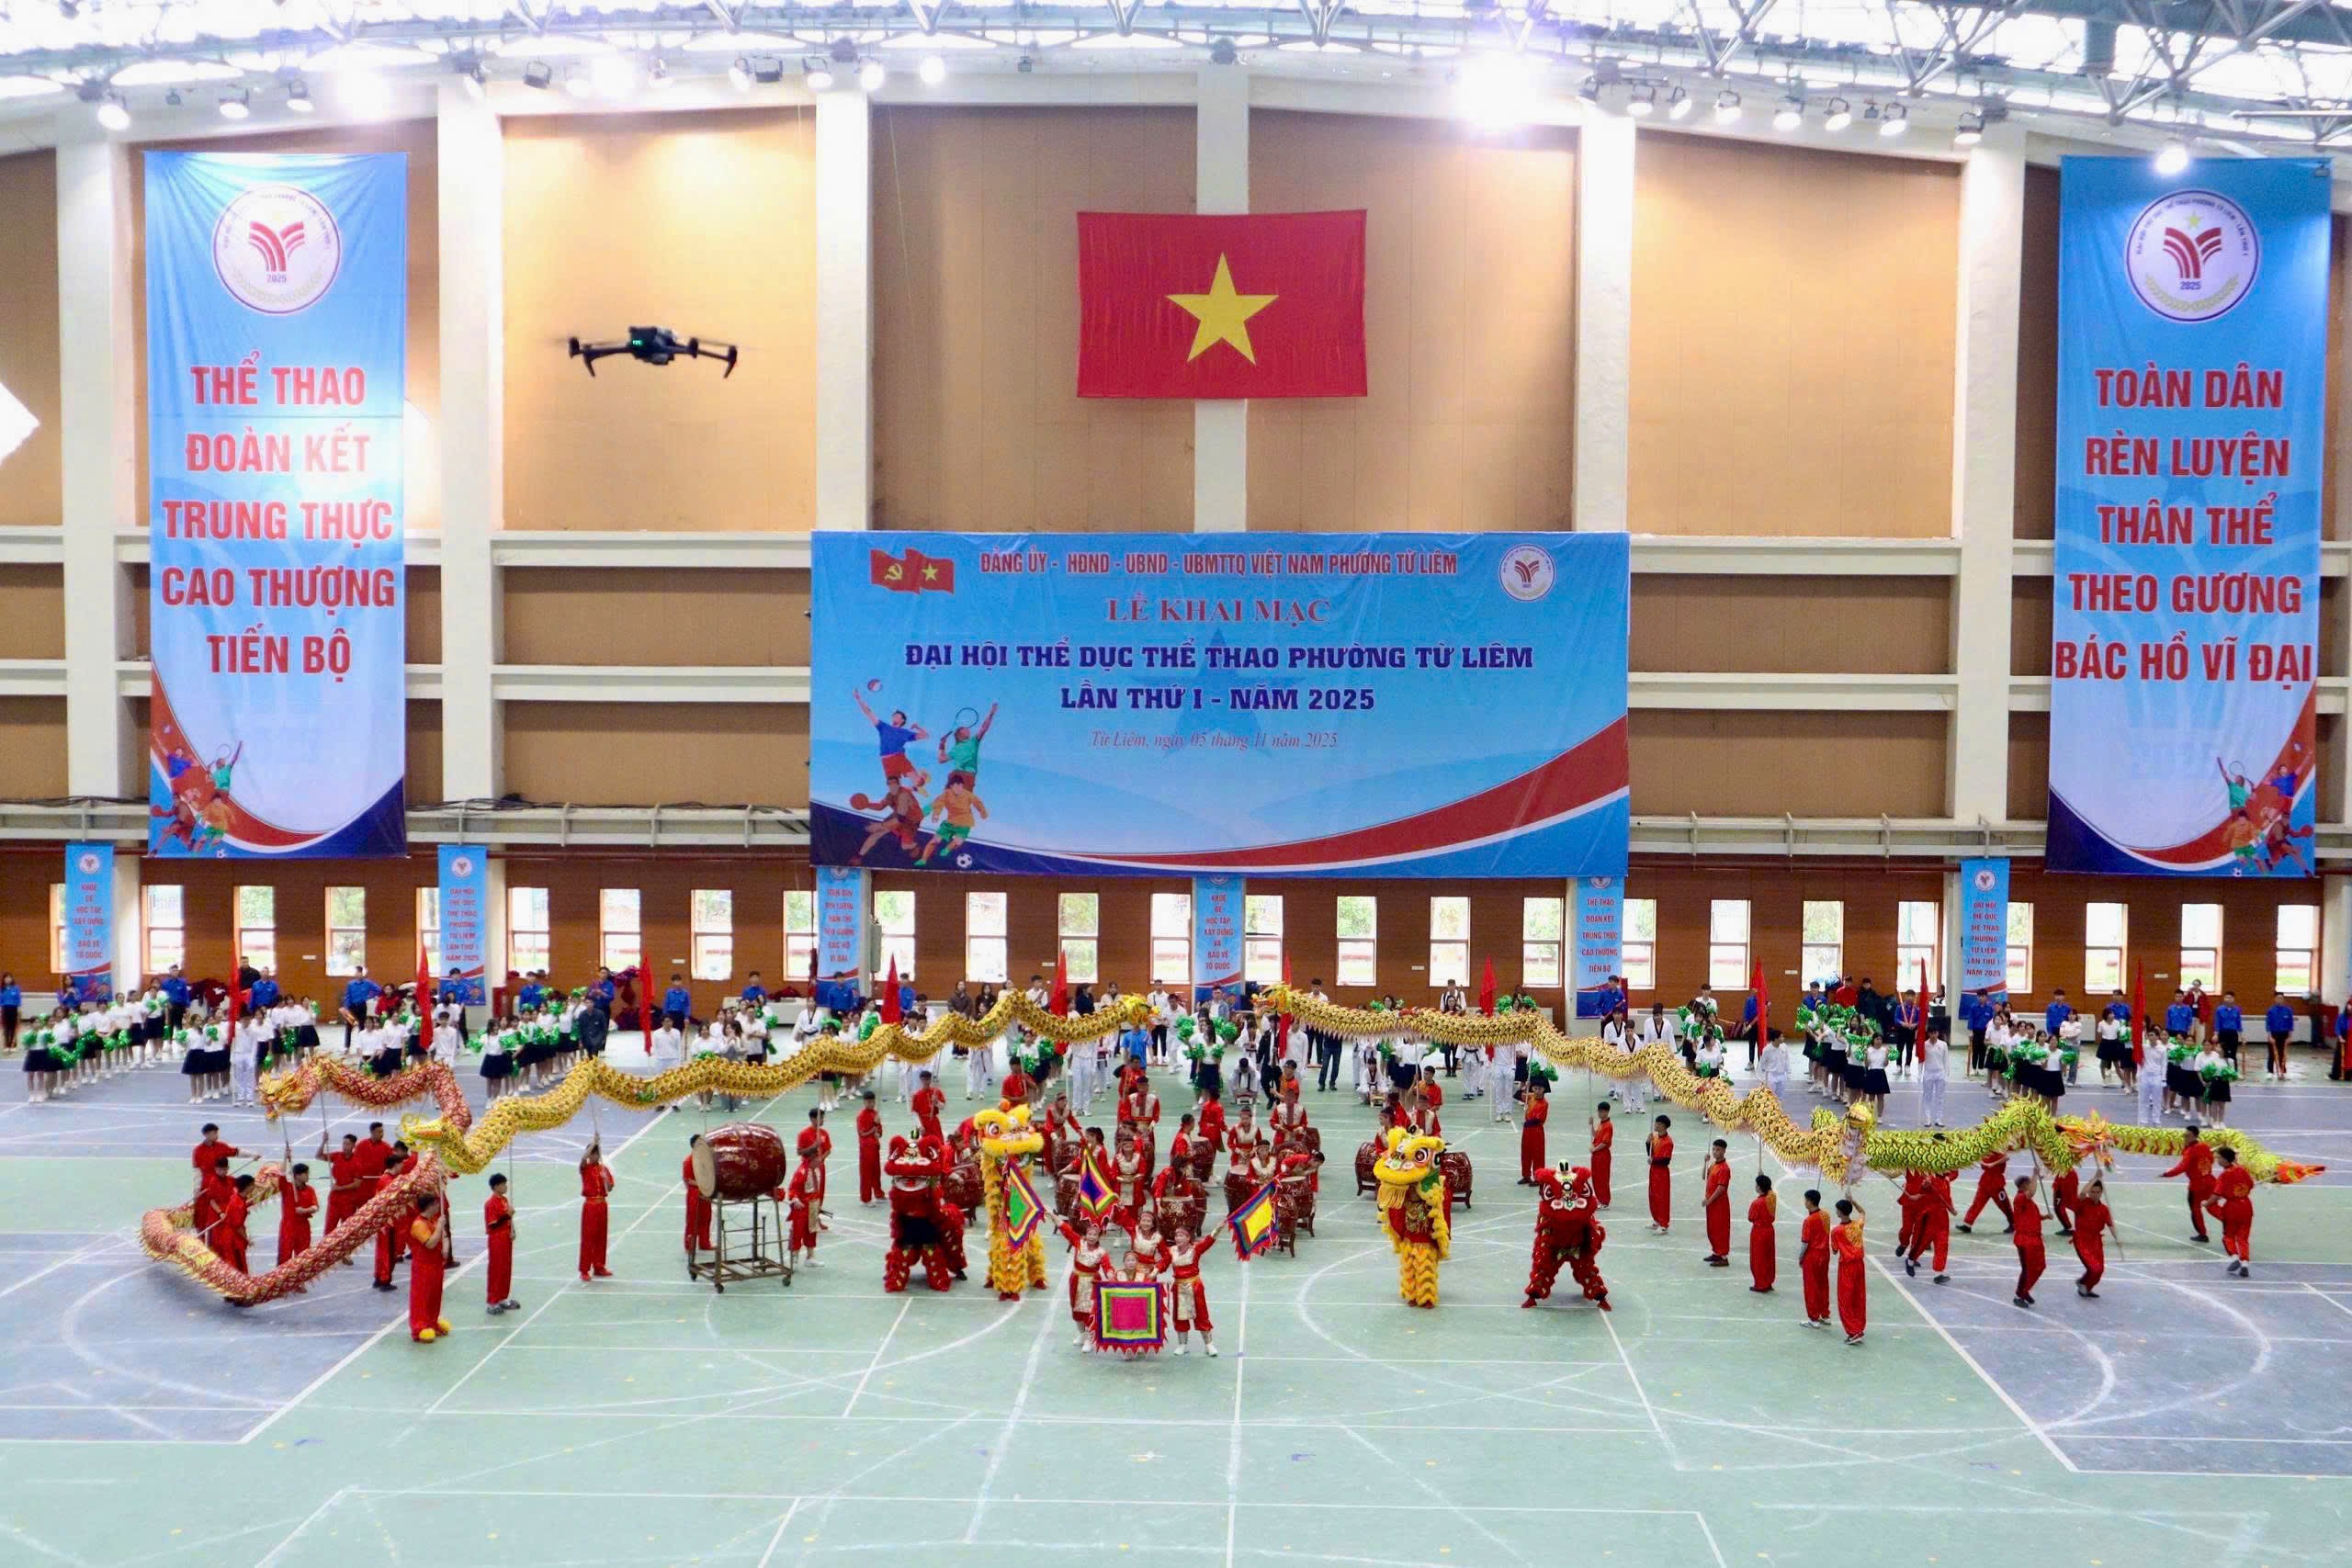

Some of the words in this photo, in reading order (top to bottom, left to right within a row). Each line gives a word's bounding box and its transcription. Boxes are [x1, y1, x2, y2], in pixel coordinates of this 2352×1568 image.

[266, 274, 288, 283] 2025
[190, 349, 262, 405] THỂ
[271, 367, 365, 405] THAO
[2094, 361, 2192, 409] TOÀN
[2204, 362, 2283, 409] DÂN
[185, 426, 291, 472] ĐOÀN
[303, 422, 371, 472] KẾT
[2085, 429, 2158, 476] RÈN
[2171, 431, 2290, 485] LUYỆN
[162, 500, 287, 540] TRUNG
[300, 498, 393, 548] THỰC
[2098, 499, 2193, 545] THÂN
[2206, 491, 2278, 545] THỂ
[979, 546, 1023, 574] ĐẢNG
[1028, 545, 1047, 574] ỦY
[1067, 553, 1110, 574] HĐND
[1125, 553, 1169, 574] UBND
[1183, 553, 1246, 576] UBMTTQ
[1250, 549, 1283, 579] VIỆT
[1287, 554, 1324, 574] NAM
[1329, 550, 1391, 574] PHƯỜNG
[1396, 550, 1417, 574] TỪ
[1419, 550, 1457, 574] LIÊM
[161, 567, 235, 607] CAO
[248, 565, 396, 615] THƯỢNG
[1159, 599, 1243, 622] KHAI
[1255, 599, 1330, 627] MẠC
[2068, 574, 2158, 613] THEO
[2171, 571, 2302, 614] GƯƠNG
[206, 623, 289, 674] TIẾN
[302, 627, 351, 682] BỘ
[905, 644, 953, 670] ĐẠI
[961, 640, 1008, 671] HỘI
[1016, 637, 1070, 668] THỂ
[1079, 646, 1134, 671] DỤC
[1141, 637, 1196, 668] THỂ
[1204, 647, 1280, 669] THAO
[1288, 642, 1406, 669] PHƯỜNG
[1414, 642, 1454, 669] TỪ
[1462, 642, 1533, 669] LIÊM
[2055, 634, 2128, 679] BÁC
[2141, 631, 2189, 681] HỒ
[2201, 637, 2235, 681] VĨ
[2248, 644, 2312, 690] ĐẠI
[1060, 679, 1118, 709] LẦN
[1126, 683, 1186, 709] THỨ
[1193, 687, 1203, 709] I
[1229, 683, 1299, 710] NĂM
[1307, 688, 1375, 710] 2025
